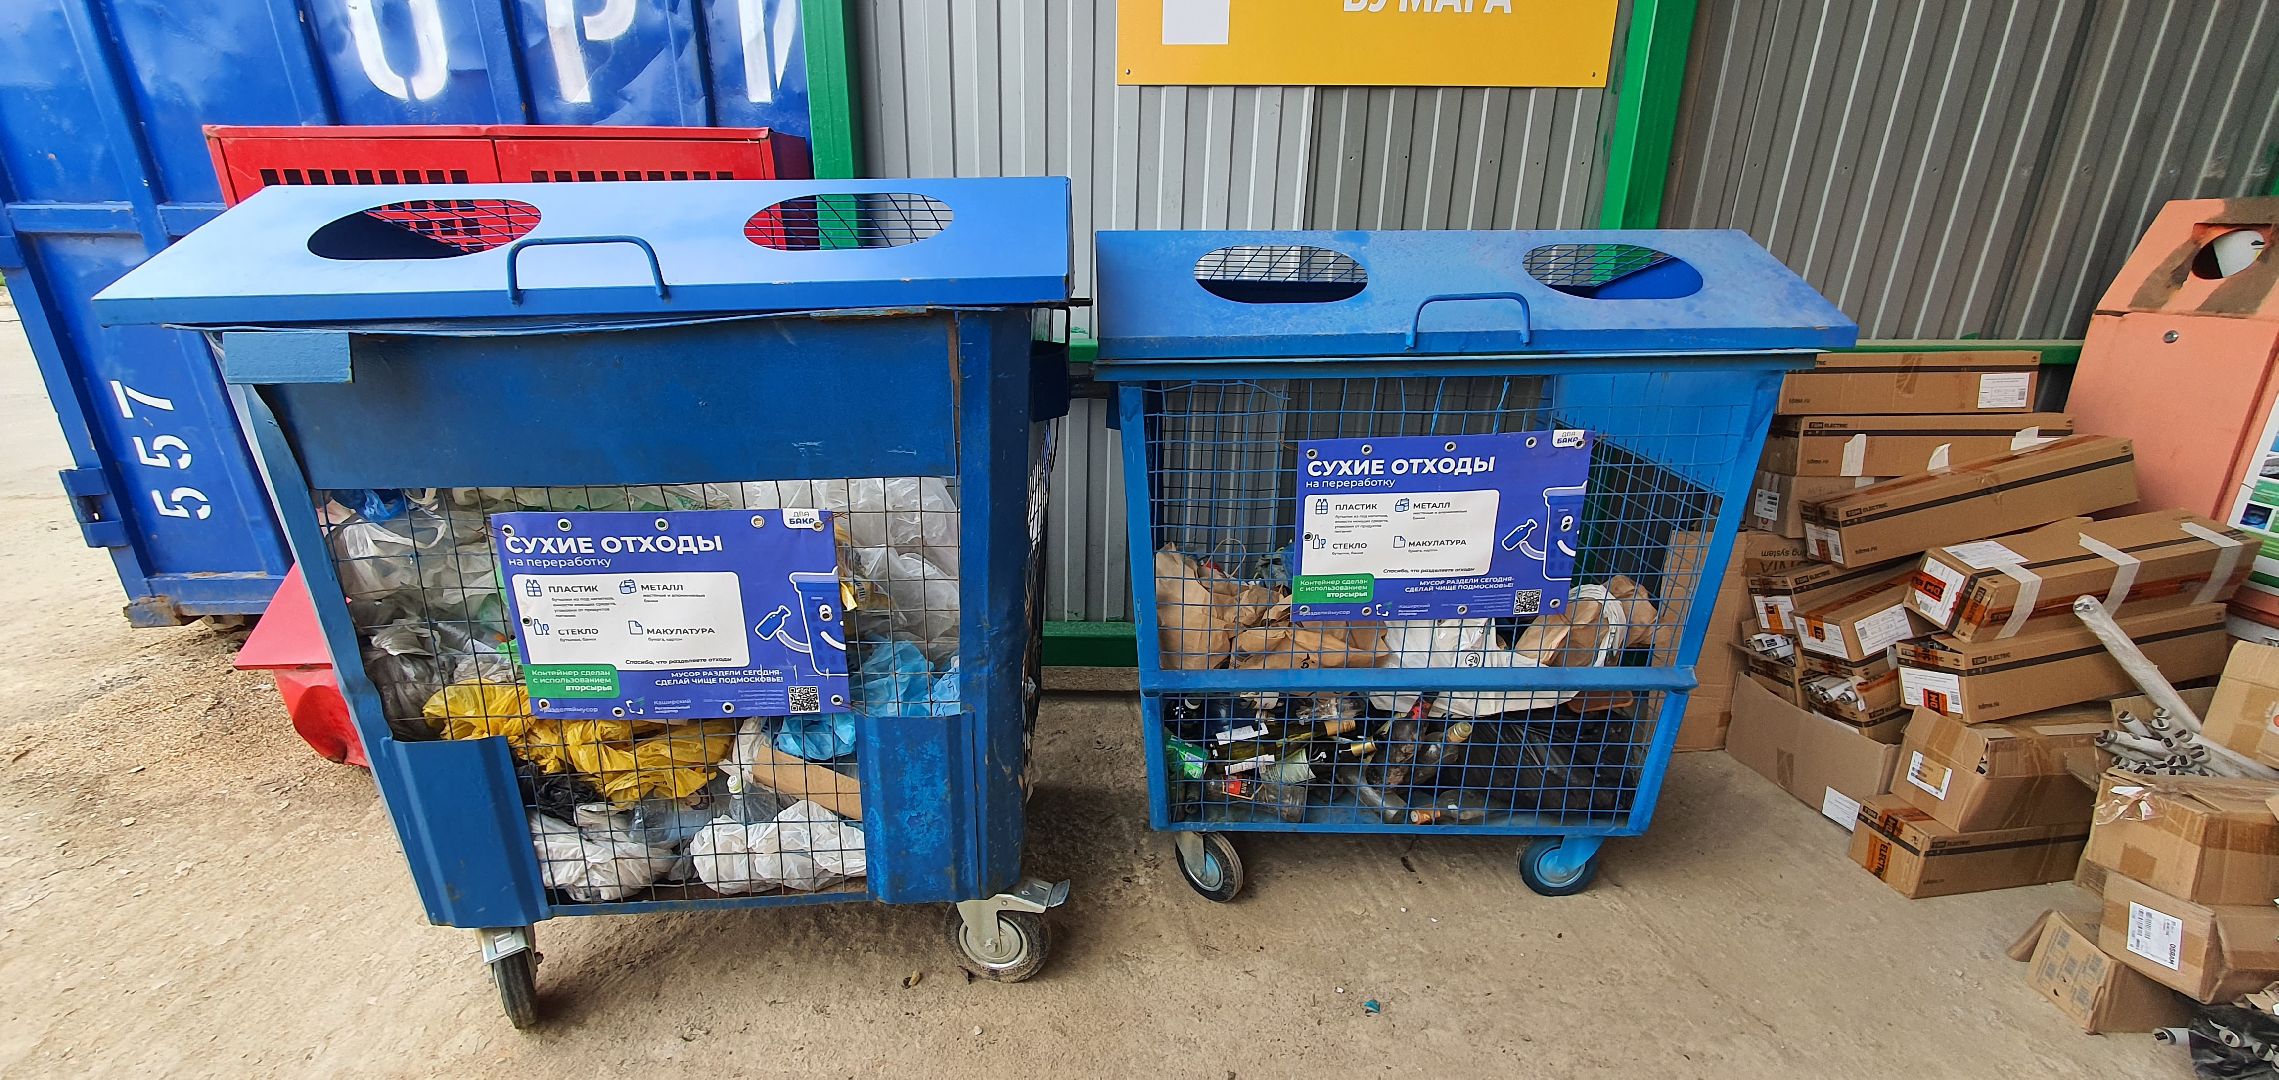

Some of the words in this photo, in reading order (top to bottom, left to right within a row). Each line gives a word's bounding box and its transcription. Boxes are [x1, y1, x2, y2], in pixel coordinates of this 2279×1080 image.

[110, 380, 211, 520] 557
[1307, 459, 1385, 476] СУХИЕ
[1391, 456, 1496, 475] ОТХОДЫ
[1322, 478, 1396, 489] переработку
[1335, 503, 1378, 511] ПЛАСТИК
[1413, 502, 1451, 510] МЕТАЛЛ
[1863, 503, 1888, 512] ELECTRIC
[505, 536, 595, 554] СУХИЕ
[600, 535, 723, 555] ОТХОДЫ
[1409, 540, 1467, 548] МАКУЛАТУРА
[1761, 547, 1790, 557] system
[508, 559, 524, 567] на
[527, 557, 612, 568] переработку
[548, 584, 599, 593] ПЛАСТИК
[640, 584, 685, 592] МЕТАЛЛ
[1305, 584, 1368, 592] использованием
[1405, 585, 1434, 593] СДЕЛАЙ
[558, 628, 599, 636] СТЕКЛО
[646, 627, 716, 636] МАКУЛАТУРА
[668, 657, 707, 665] разделяете
[532, 669, 579, 677] Контейнер
[742, 669, 783, 677] СЕГОДНЯ-
[655, 678, 690, 686] СДЕЛАЙ
[719, 676, 784, 684] ПОДМОСКОВЬЕ!
[566, 684, 613, 692] вторсырья
